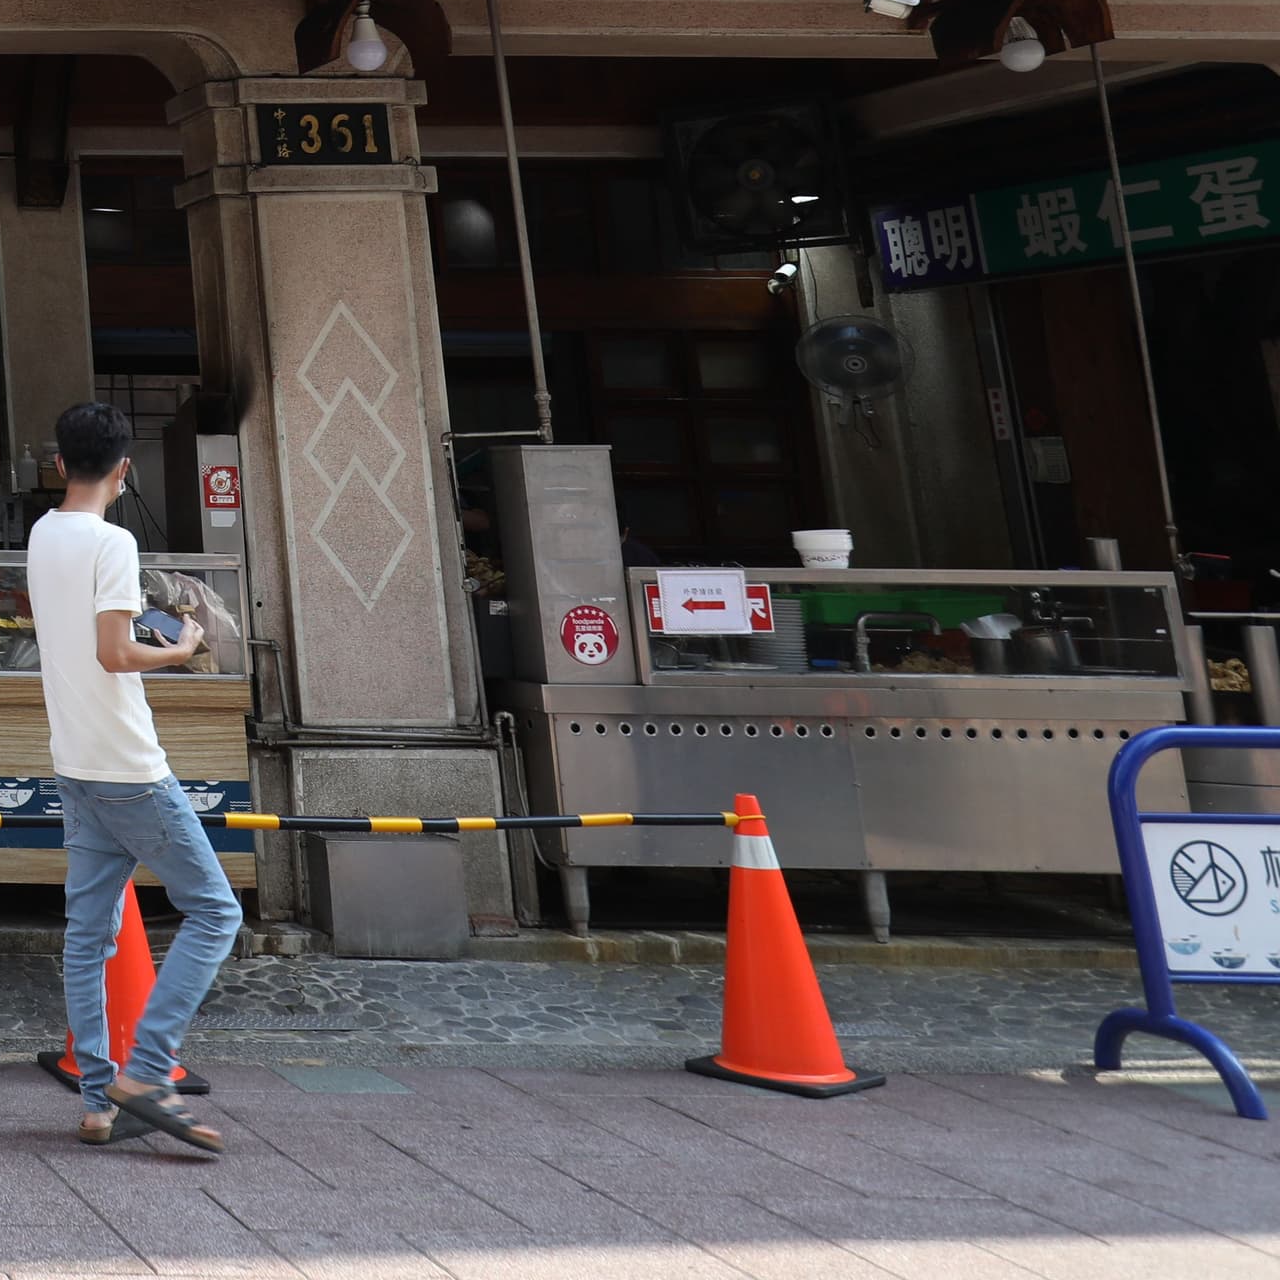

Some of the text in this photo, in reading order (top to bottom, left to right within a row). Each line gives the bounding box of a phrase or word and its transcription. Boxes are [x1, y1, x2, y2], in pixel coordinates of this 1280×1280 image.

[883, 206, 976, 278] 聰明
[1016, 156, 1271, 258] 蝦仁蛋
[572, 618, 604, 626] foodpanda
